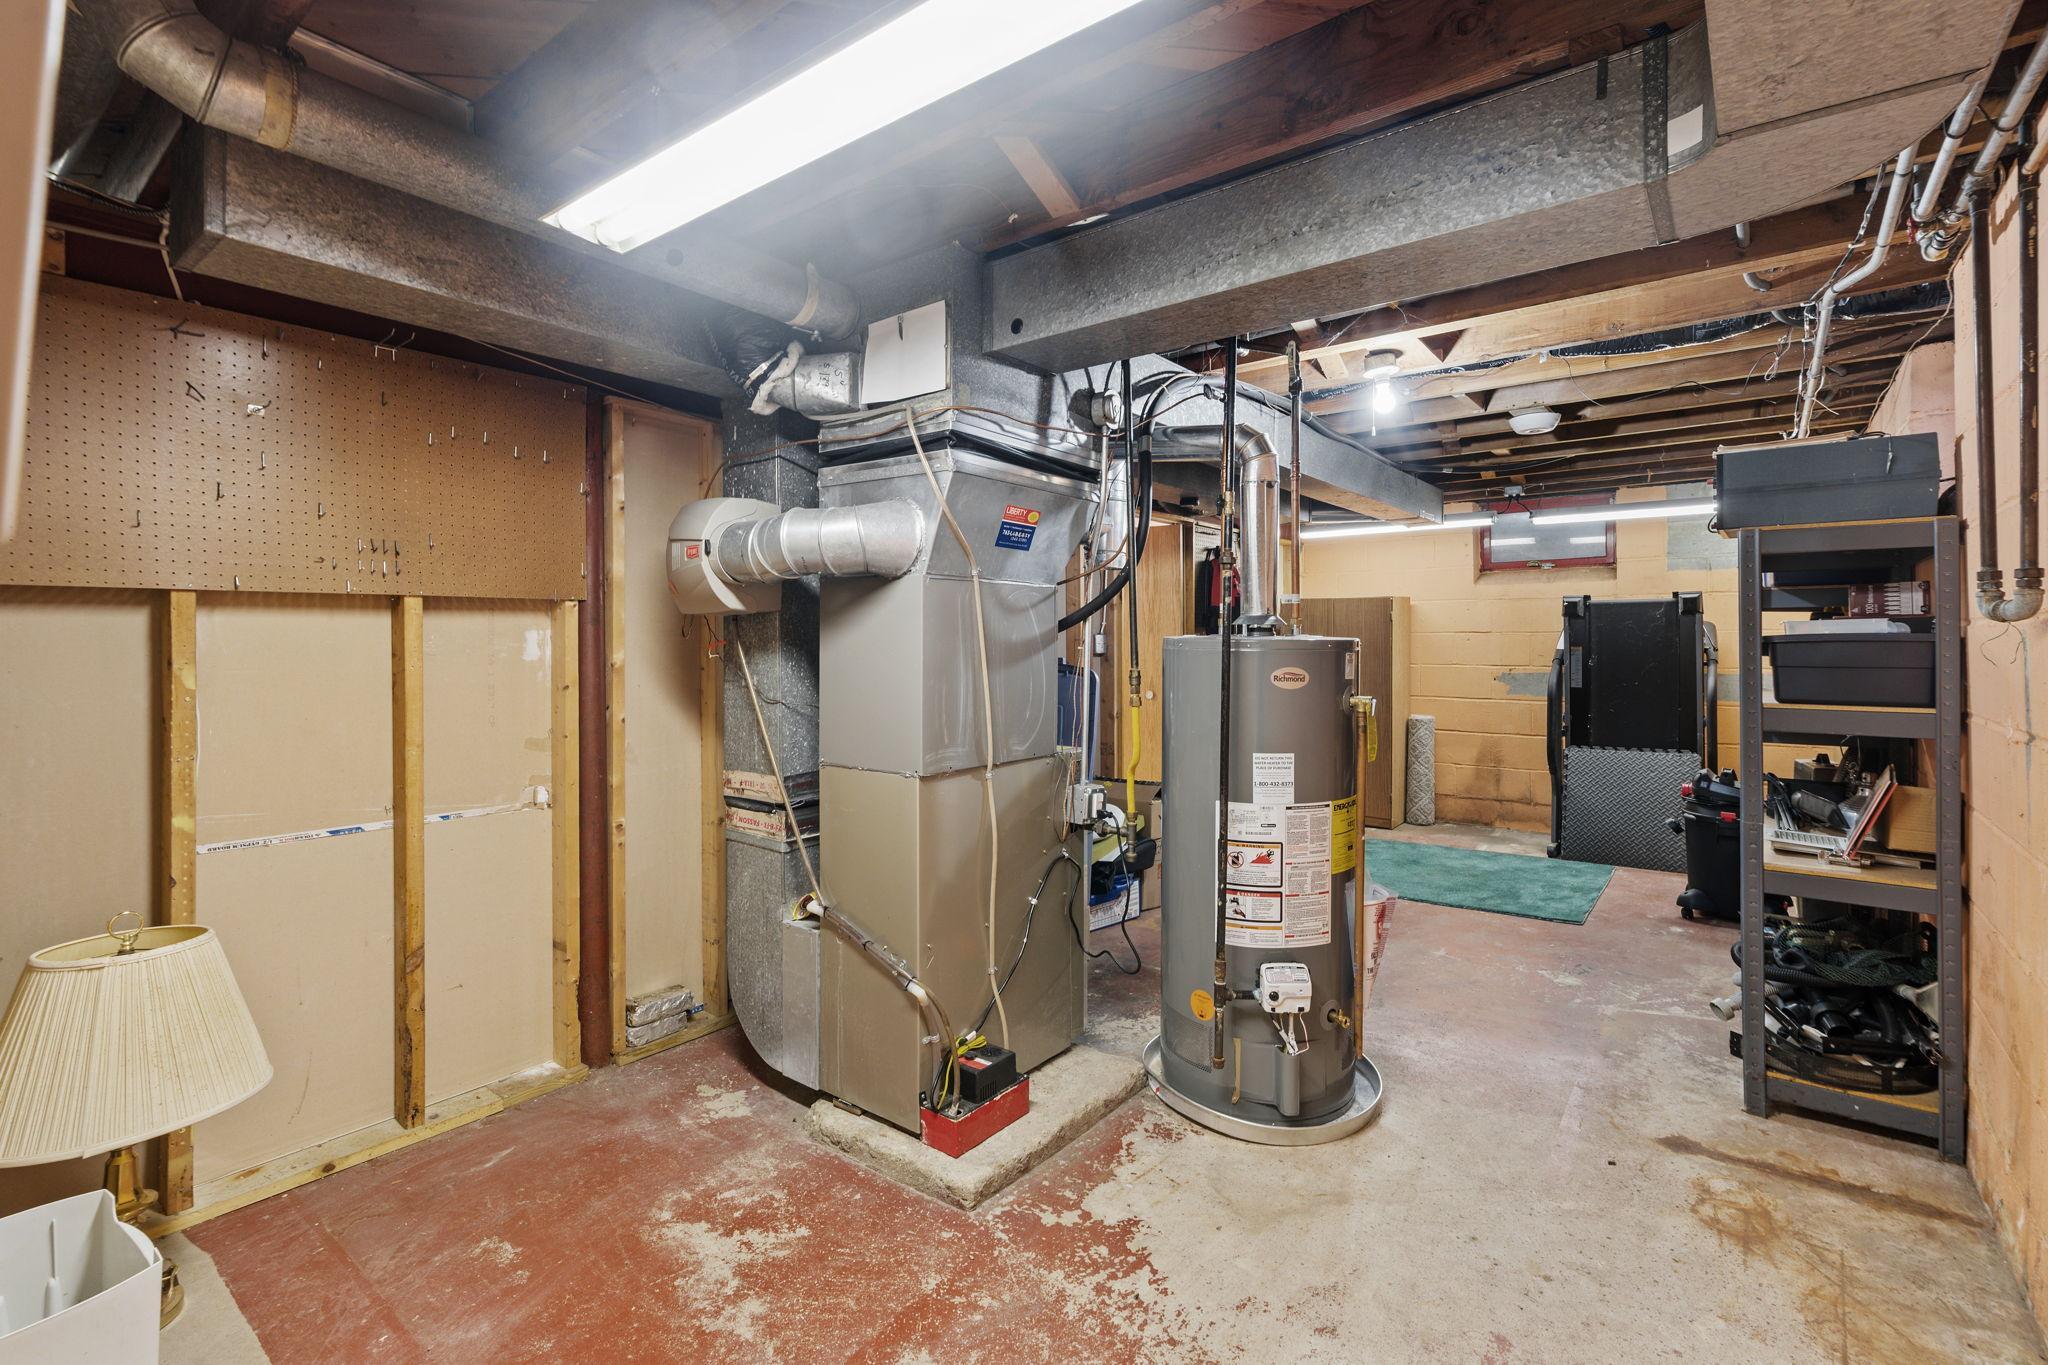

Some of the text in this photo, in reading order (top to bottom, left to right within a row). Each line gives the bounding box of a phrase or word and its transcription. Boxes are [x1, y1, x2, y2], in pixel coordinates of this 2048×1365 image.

[1006, 506, 1027, 516] LIBERTY
[1865, 603, 1874, 614] 100
[1273, 674, 1306, 683] Richmond
